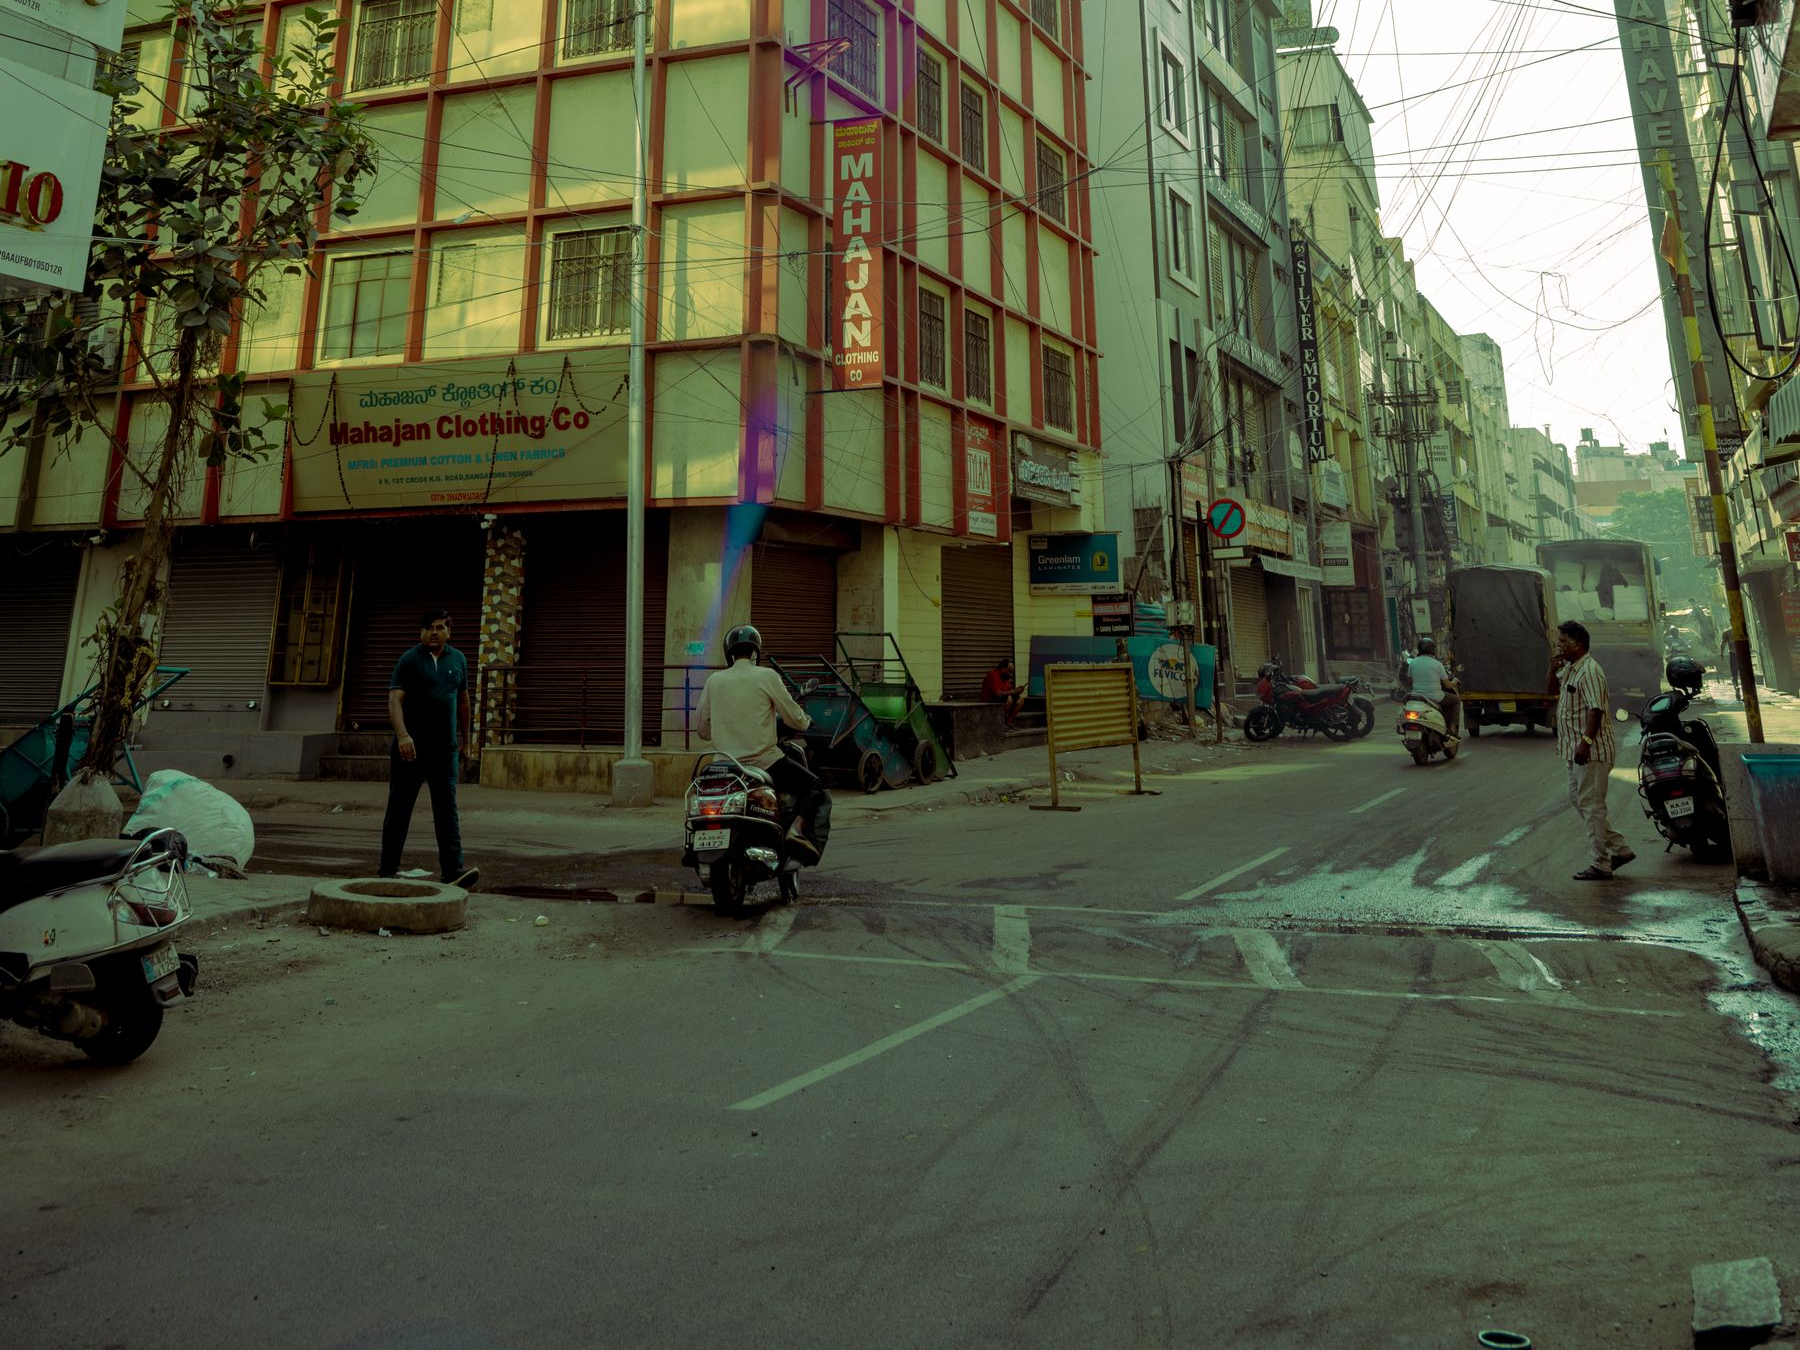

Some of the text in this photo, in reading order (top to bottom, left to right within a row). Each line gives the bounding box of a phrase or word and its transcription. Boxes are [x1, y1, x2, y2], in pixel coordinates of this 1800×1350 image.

[840, 152, 874, 349] MAHAJAN
[835, 350, 880, 367] CLOTHING
[1297, 260, 1327, 461] SILVER EMPORIUM
[850, 369, 863, 383] CO
[329, 406, 590, 447] Mahajan Clothing Co
[381, 456, 427, 469] PREMIUM
[430, 453, 472, 466] COTTON
[475, 452, 482, 464] &
[520, 447, 566, 462] FABRICS
[405, 475, 428, 485] CROSS
[1037, 554, 1081, 565] Greenlam
[1153, 667, 1188, 683] FEVICO
